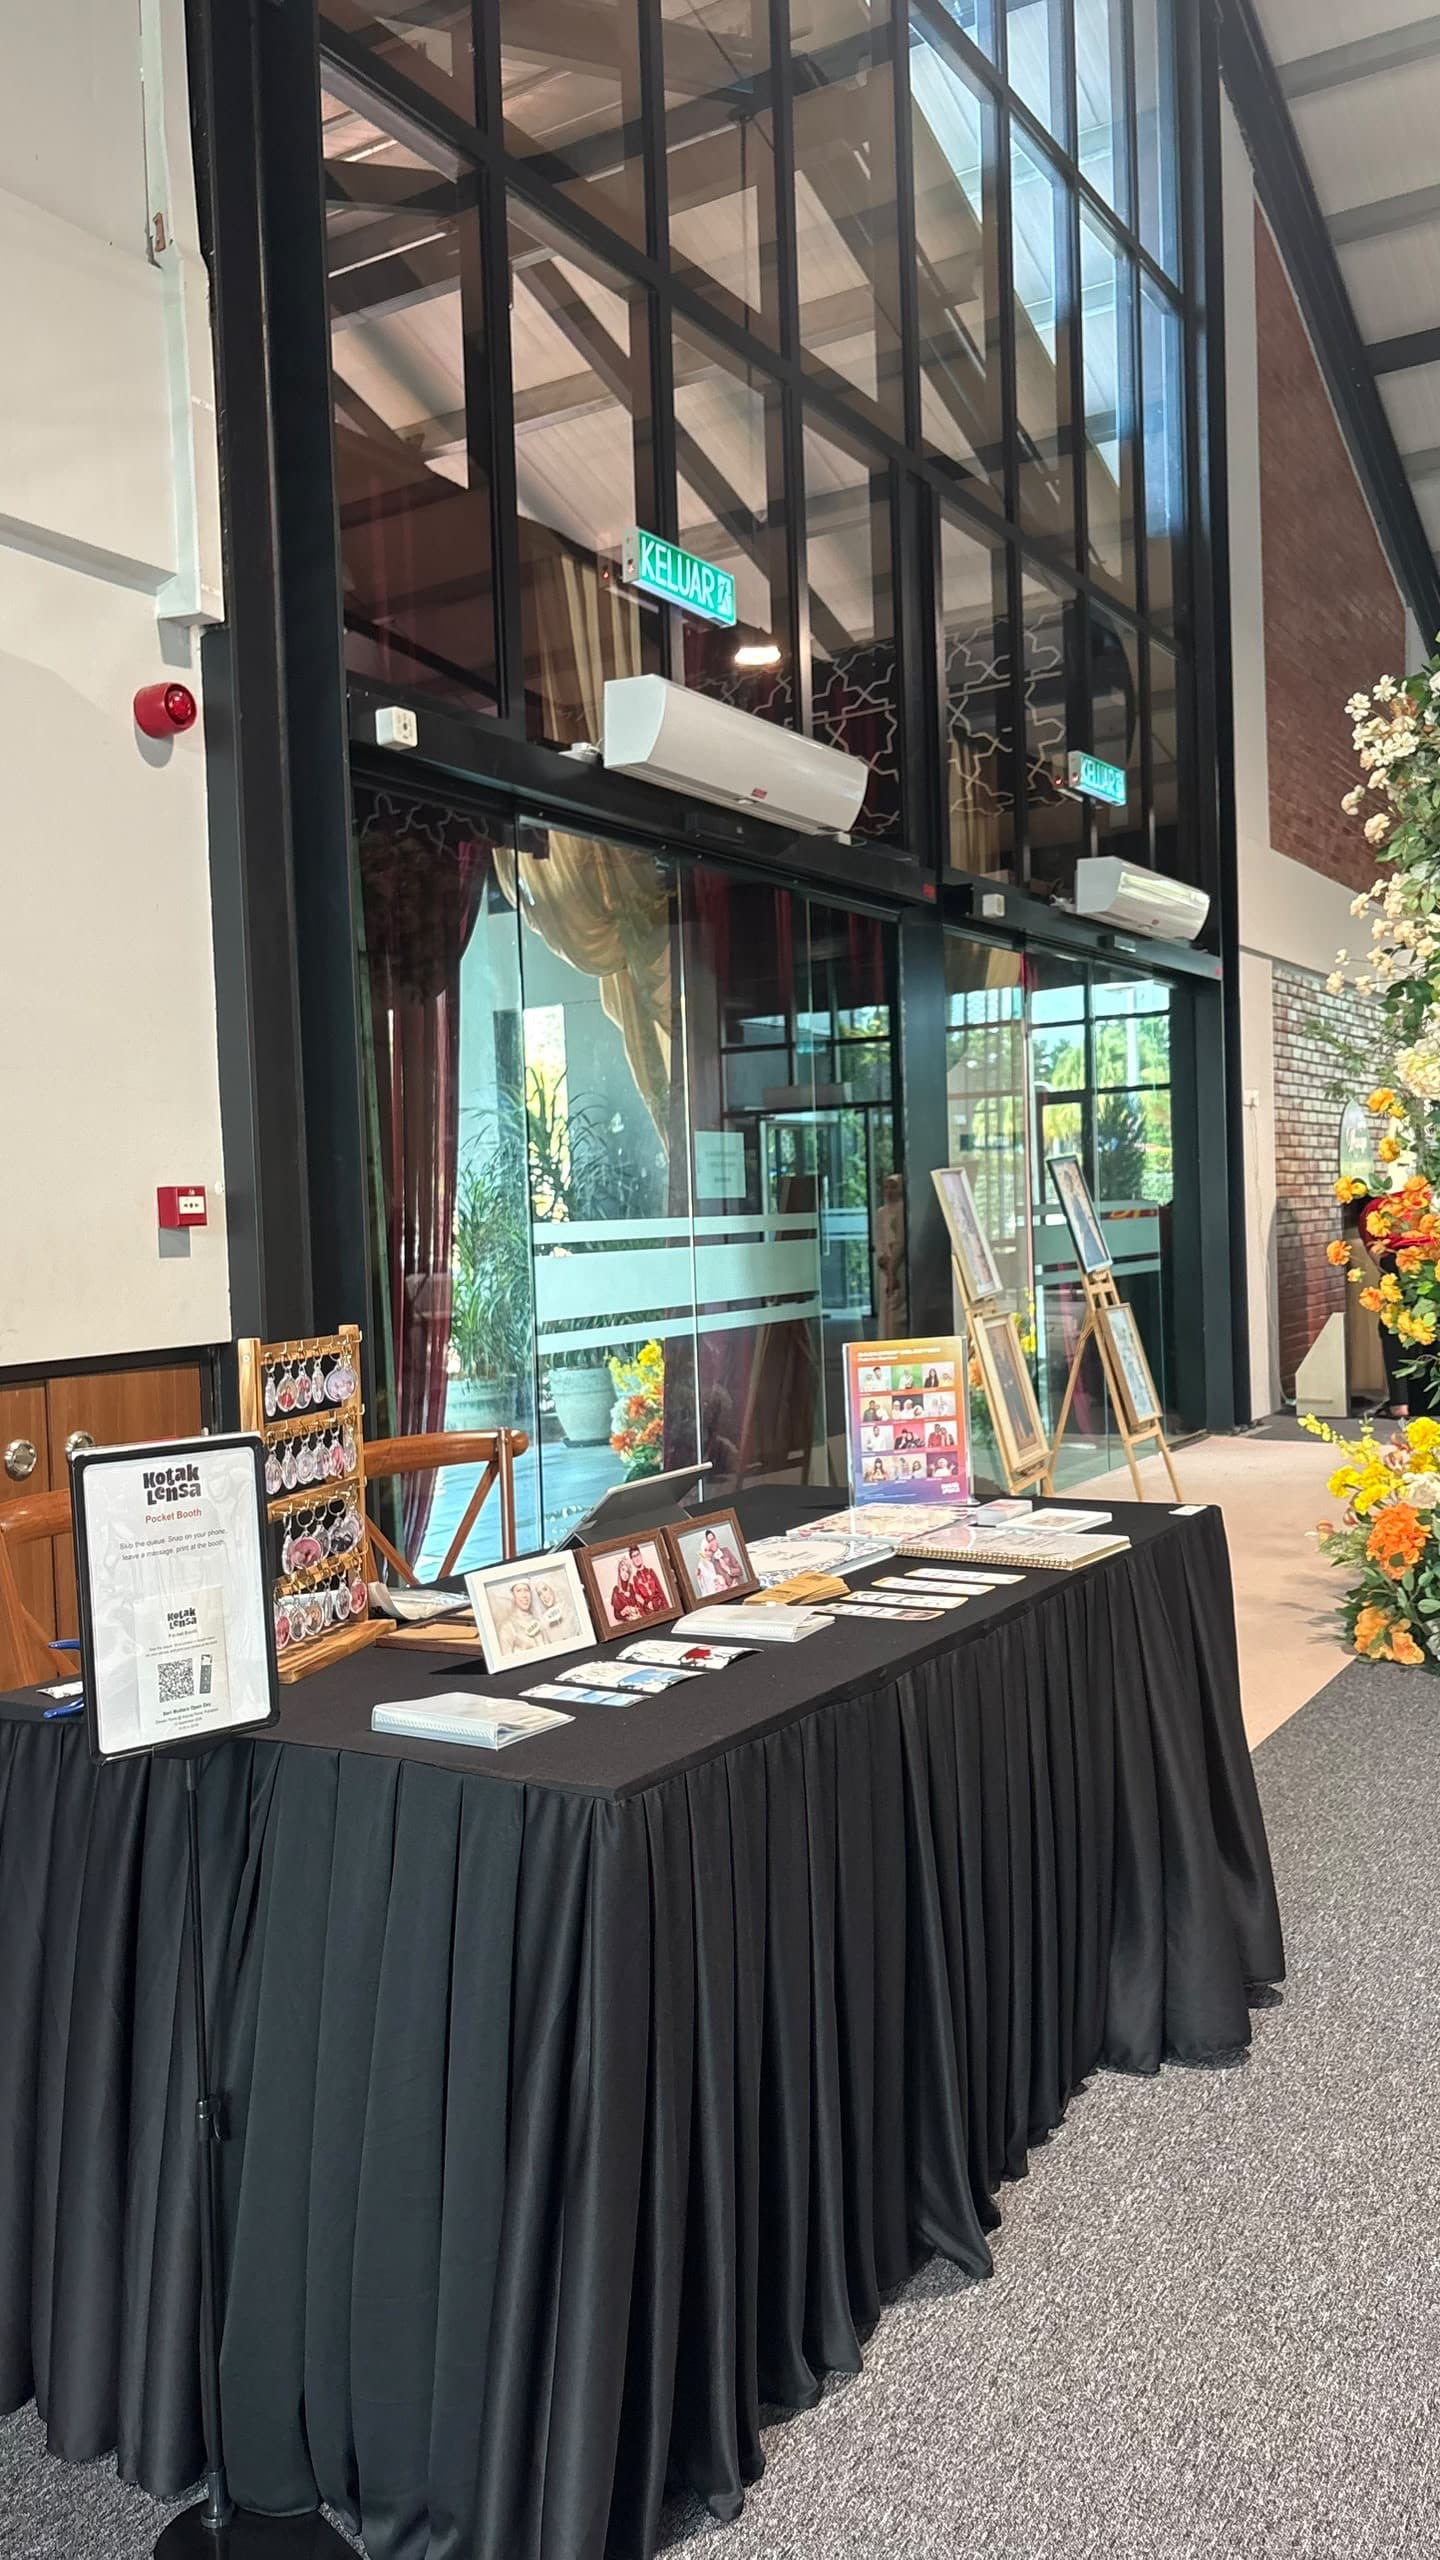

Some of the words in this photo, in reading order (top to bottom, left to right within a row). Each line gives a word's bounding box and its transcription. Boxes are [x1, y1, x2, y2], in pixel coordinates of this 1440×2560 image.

[641, 536, 716, 609] KELUAR
[142, 1463, 200, 1489] Kotak
[147, 1482, 202, 1505] Lensa
[145, 1512, 175, 1524] Pocket
[176, 1508, 202, 1519] Booth
[168, 1535, 183, 1543] Snap
[193, 1531, 206, 1540] your
[175, 1544, 189, 1554] print
[167, 1607, 196, 1621] Kotak
